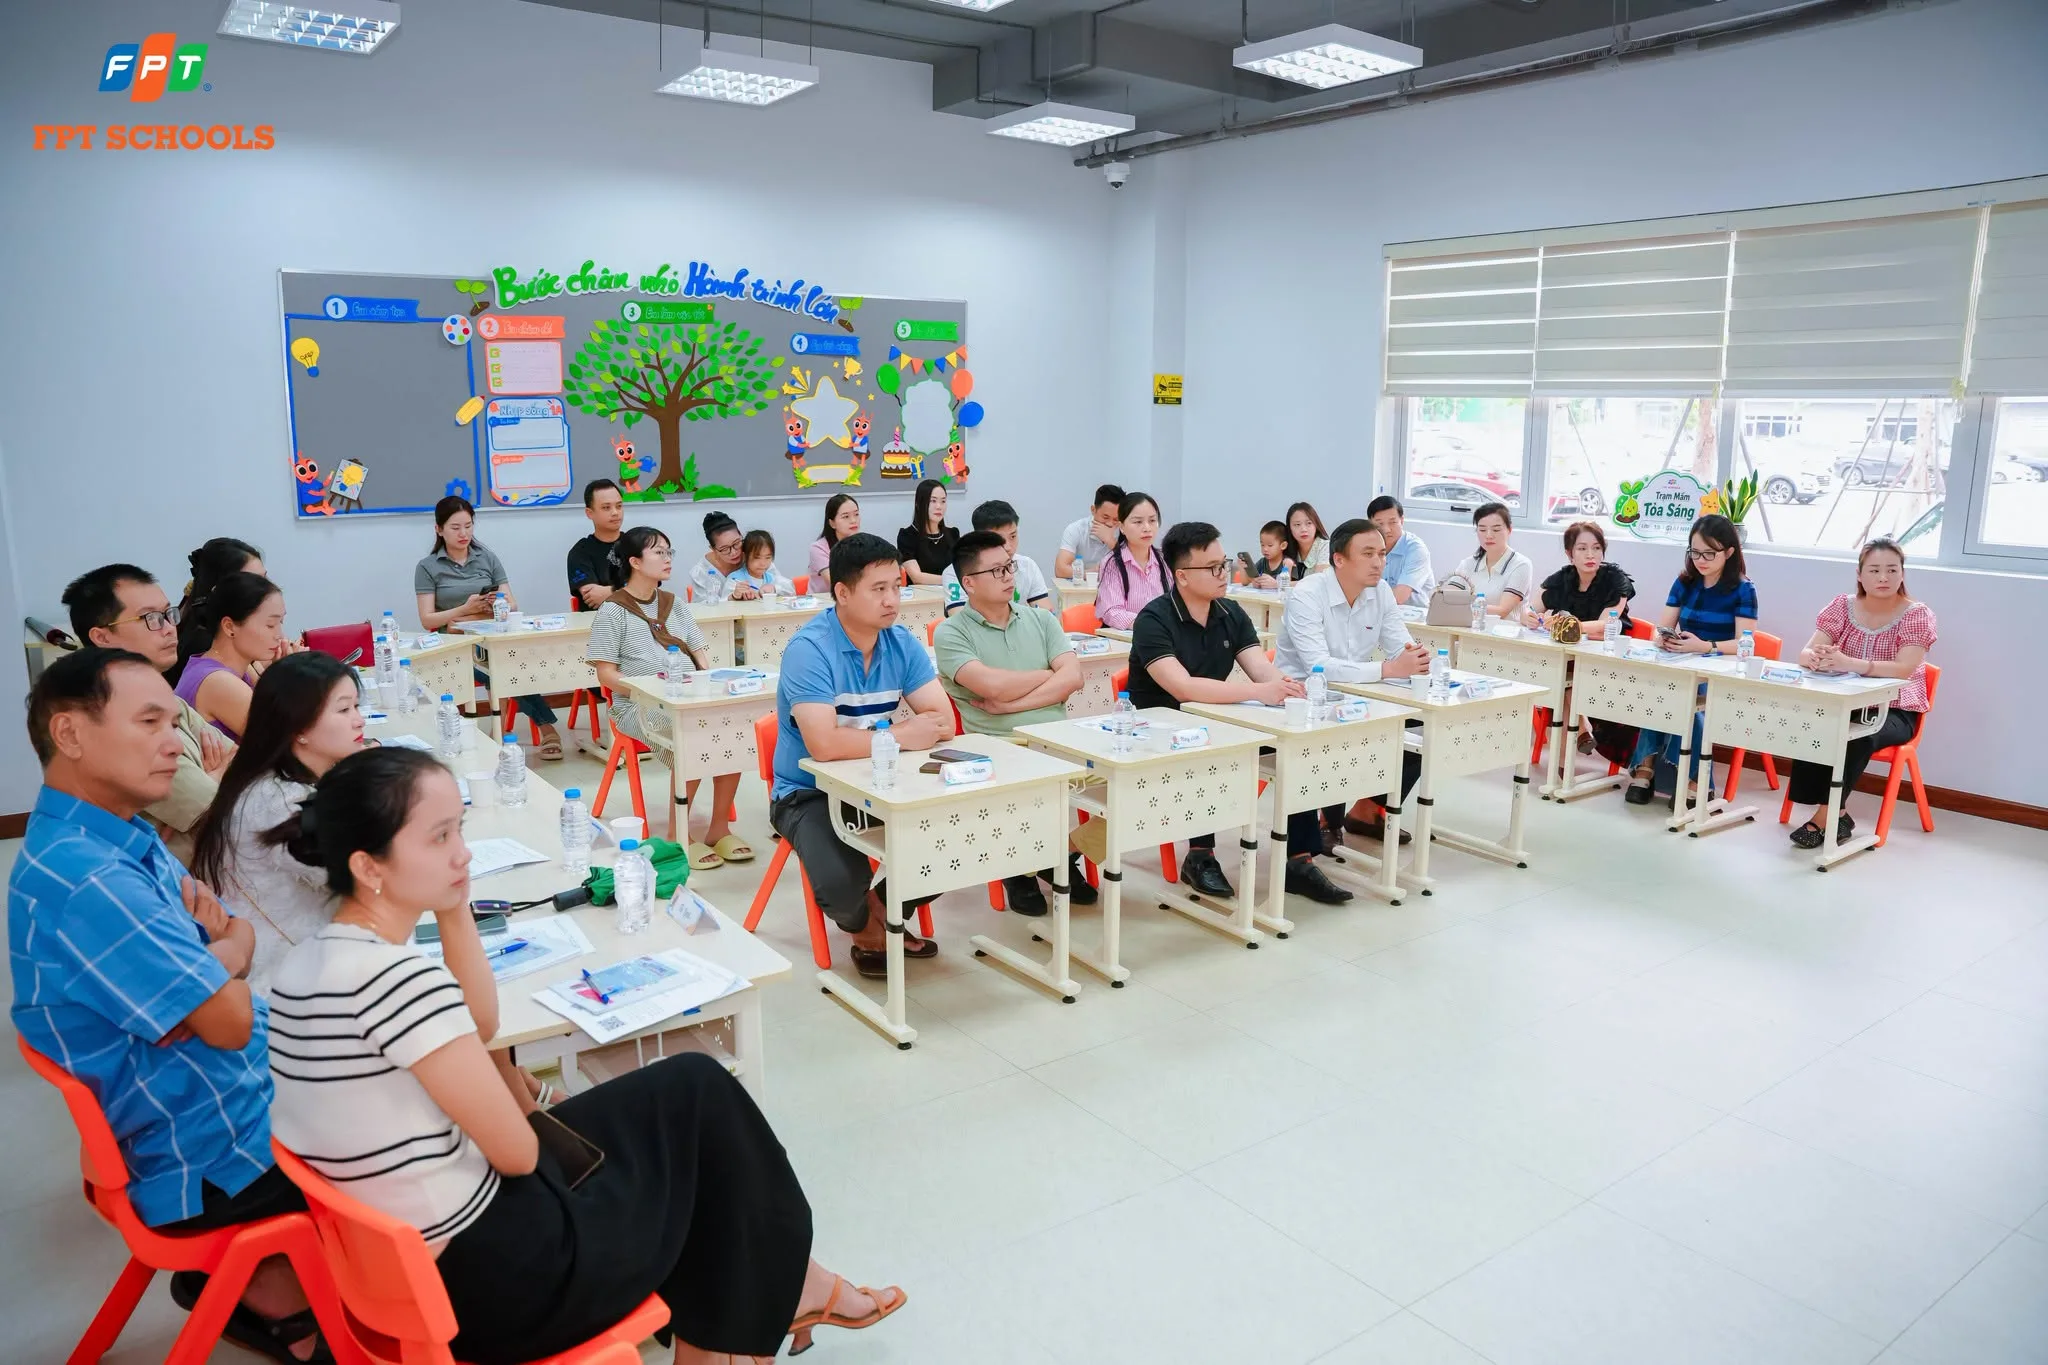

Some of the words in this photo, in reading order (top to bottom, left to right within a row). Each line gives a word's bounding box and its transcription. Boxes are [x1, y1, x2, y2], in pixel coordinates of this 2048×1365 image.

[492, 266, 560, 308] Bước
[565, 260, 630, 293] chân
[639, 263, 680, 294] nhỏ
[683, 261, 749, 298] Hành
[751, 278, 805, 313] trình
[332, 301, 339, 316] 1
[628, 307, 635, 318] 3
[484, 320, 494, 333] 2
[901, 324, 907, 335] 5
[1655, 491, 1673, 502] Trạm
[1643, 502, 1664, 517] Tỏa
[1666, 502, 1695, 521] Sáng
[948, 583, 961, 602] 3
